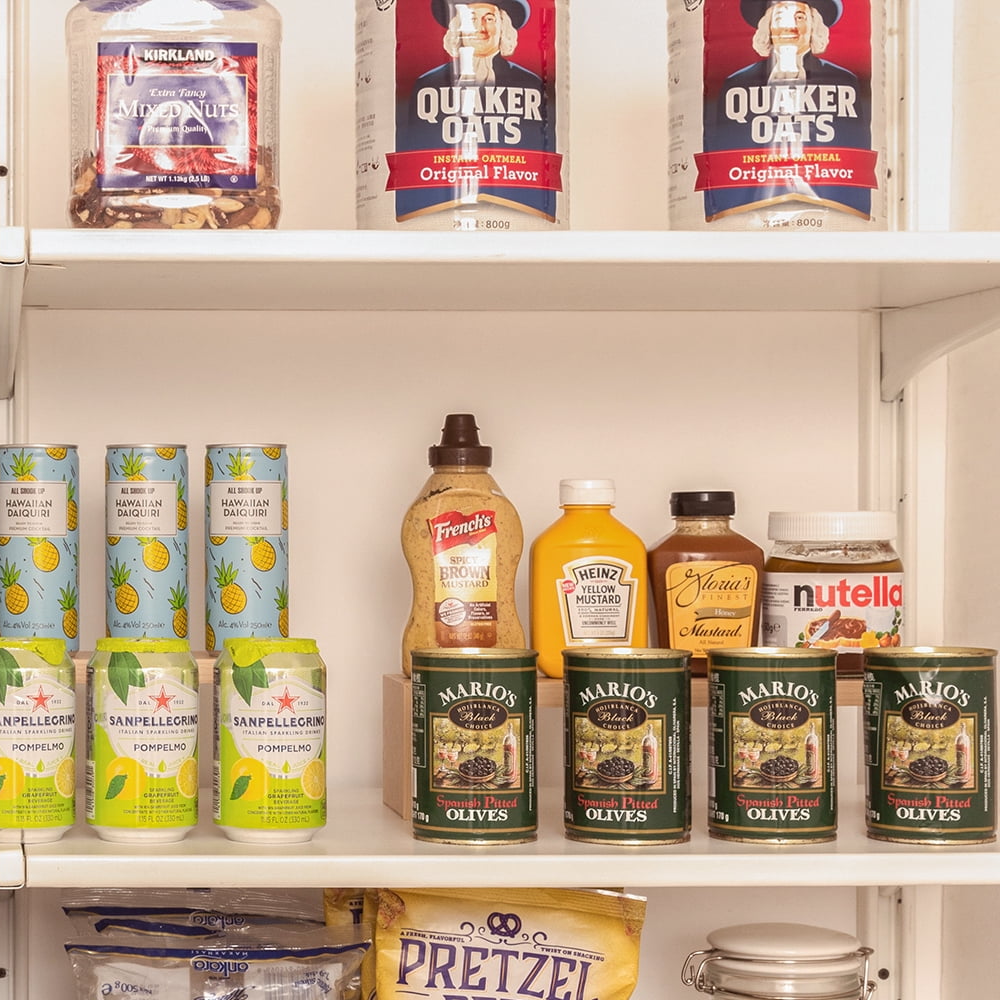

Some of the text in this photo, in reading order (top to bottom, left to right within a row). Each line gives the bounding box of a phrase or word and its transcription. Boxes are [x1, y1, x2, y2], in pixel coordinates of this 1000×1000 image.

[144, 50, 215, 61] KIRKLAND
[149, 89, 206, 99] Extra Fancy
[118, 100, 239, 118] MIXED NUTS
[417, 86, 542, 124] QUAKER
[725, 85, 858, 124] QUAKER
[182, 125, 208, 134] Quality
[442, 116, 522, 145] OATS
[751, 114, 836, 144] OATS
[482, 155, 527, 164] OATMEAL
[743, 154, 841, 163] INSTANT OATMEAL
[421, 166, 539, 182] Original Flavor
[729, 164, 854, 182] Original Flavor
[221, 499, 270, 508] HAWAIIAN
[223, 508, 267, 518] DAIQUIRI
[434, 515, 493, 543] French's
[440, 565, 490, 581] BROWN
[578, 566, 619, 582] HEINZ
[441, 580, 489, 588] MUSTARD
[581, 585, 616, 594] YELLOW
[794, 576, 902, 608] nutella
[576, 594, 621, 604] MUSTARD
[714, 608, 737, 617] Honey
[438, 682, 517, 707] MARIO'S
[579, 682, 658, 708] MARIO'S
[738, 681, 819, 707] MARIO'S
[894, 680, 971, 707] MARIO'S
[233, 715, 325, 728] SANPELLEGRINO
[459, 712, 496, 722] Black
[761, 711, 798, 722] Black
[911, 711, 947, 722] Black
[766, 722, 795, 730] CHOICE
[12, 743, 64, 752] POMPELMO
[257, 744, 312, 753] POMPELMO
[436, 796, 517, 809] Spanish Pitted
[736, 795, 820, 809] Spanish Pitted
[887, 795, 971, 809] Spanish Pitted
[446, 809, 508, 822] OLIVES
[586, 809, 647, 822] OLIVES
[747, 808, 810, 821] OLIVES
[896, 808, 961, 821] OLIVES
[429, 934, 465, 943] FLAVORFUL
[573, 951, 605, 962] SNACKING
[190, 958, 249, 978] ankara
